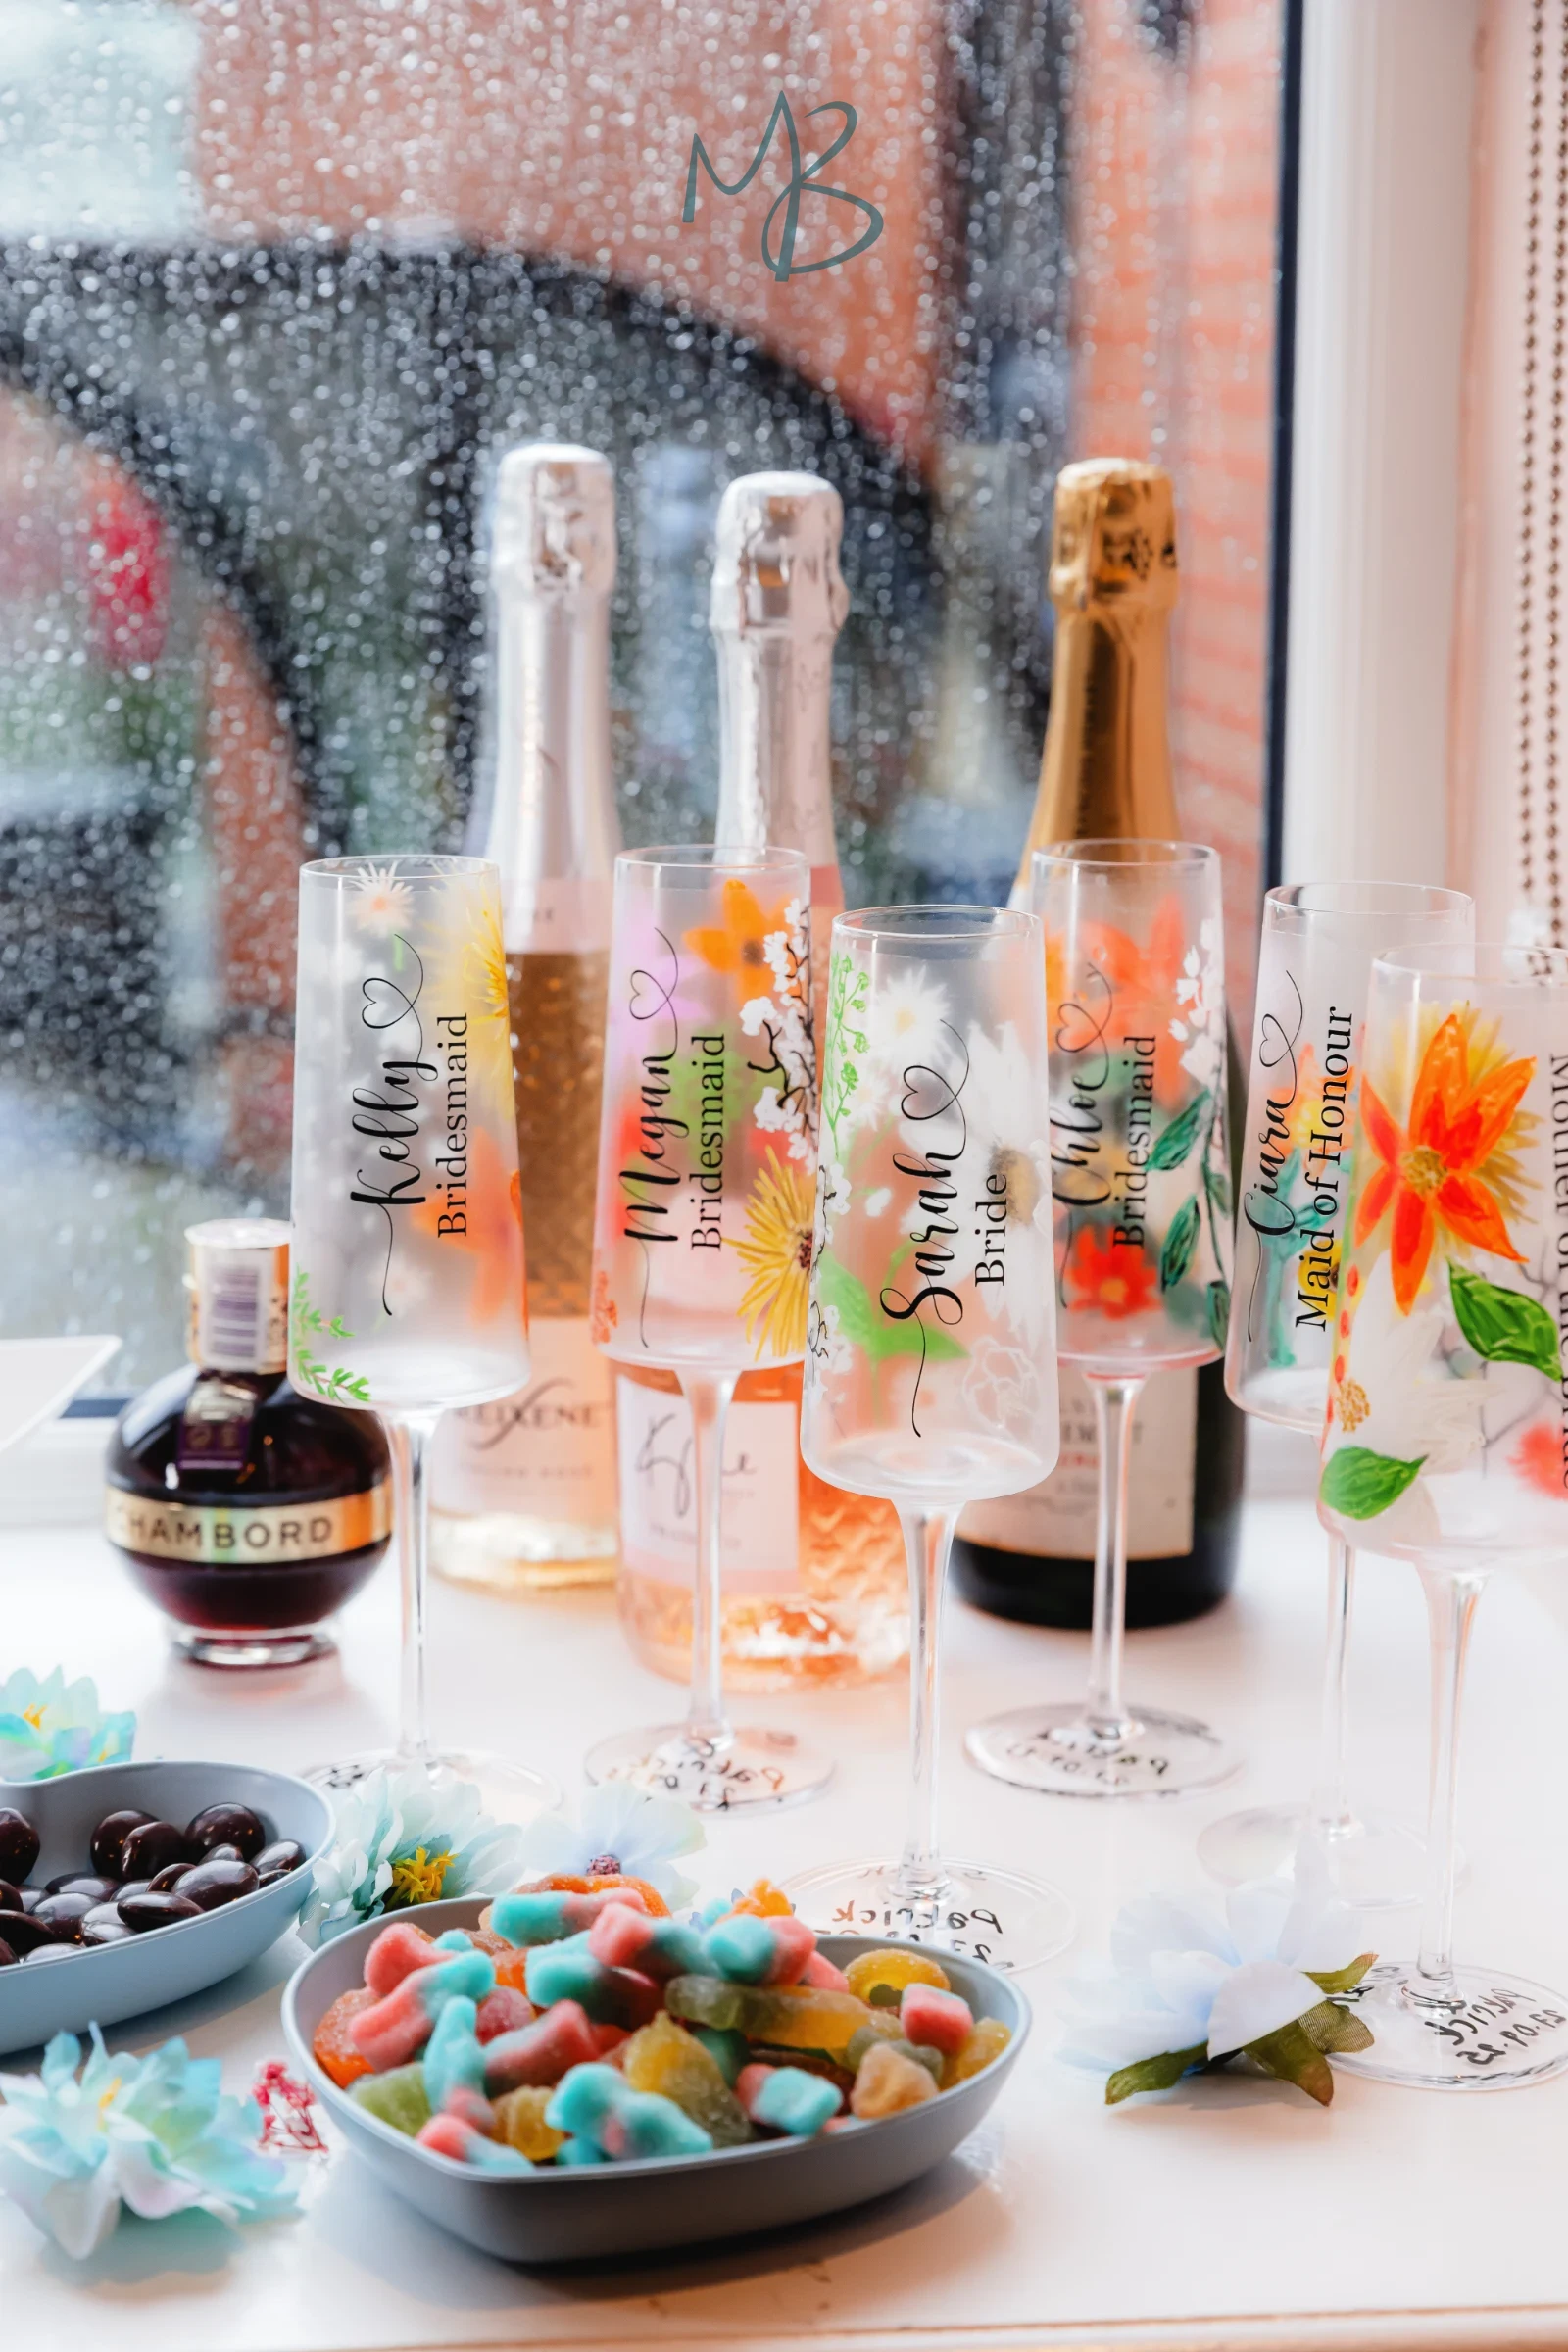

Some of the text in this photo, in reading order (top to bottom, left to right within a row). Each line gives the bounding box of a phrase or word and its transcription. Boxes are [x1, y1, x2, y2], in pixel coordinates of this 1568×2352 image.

[437, 1012, 468, 1239] Bridesmaid
[690, 1033, 725, 1251] Bridesmaid
[975, 1173, 1007, 1287] Bride
[1113, 1035, 1156, 1249] Bridesmaid
[1295, 1005, 1353, 1332] Maid of Honour
[116, 1503, 334, 1549] HAMBORD
